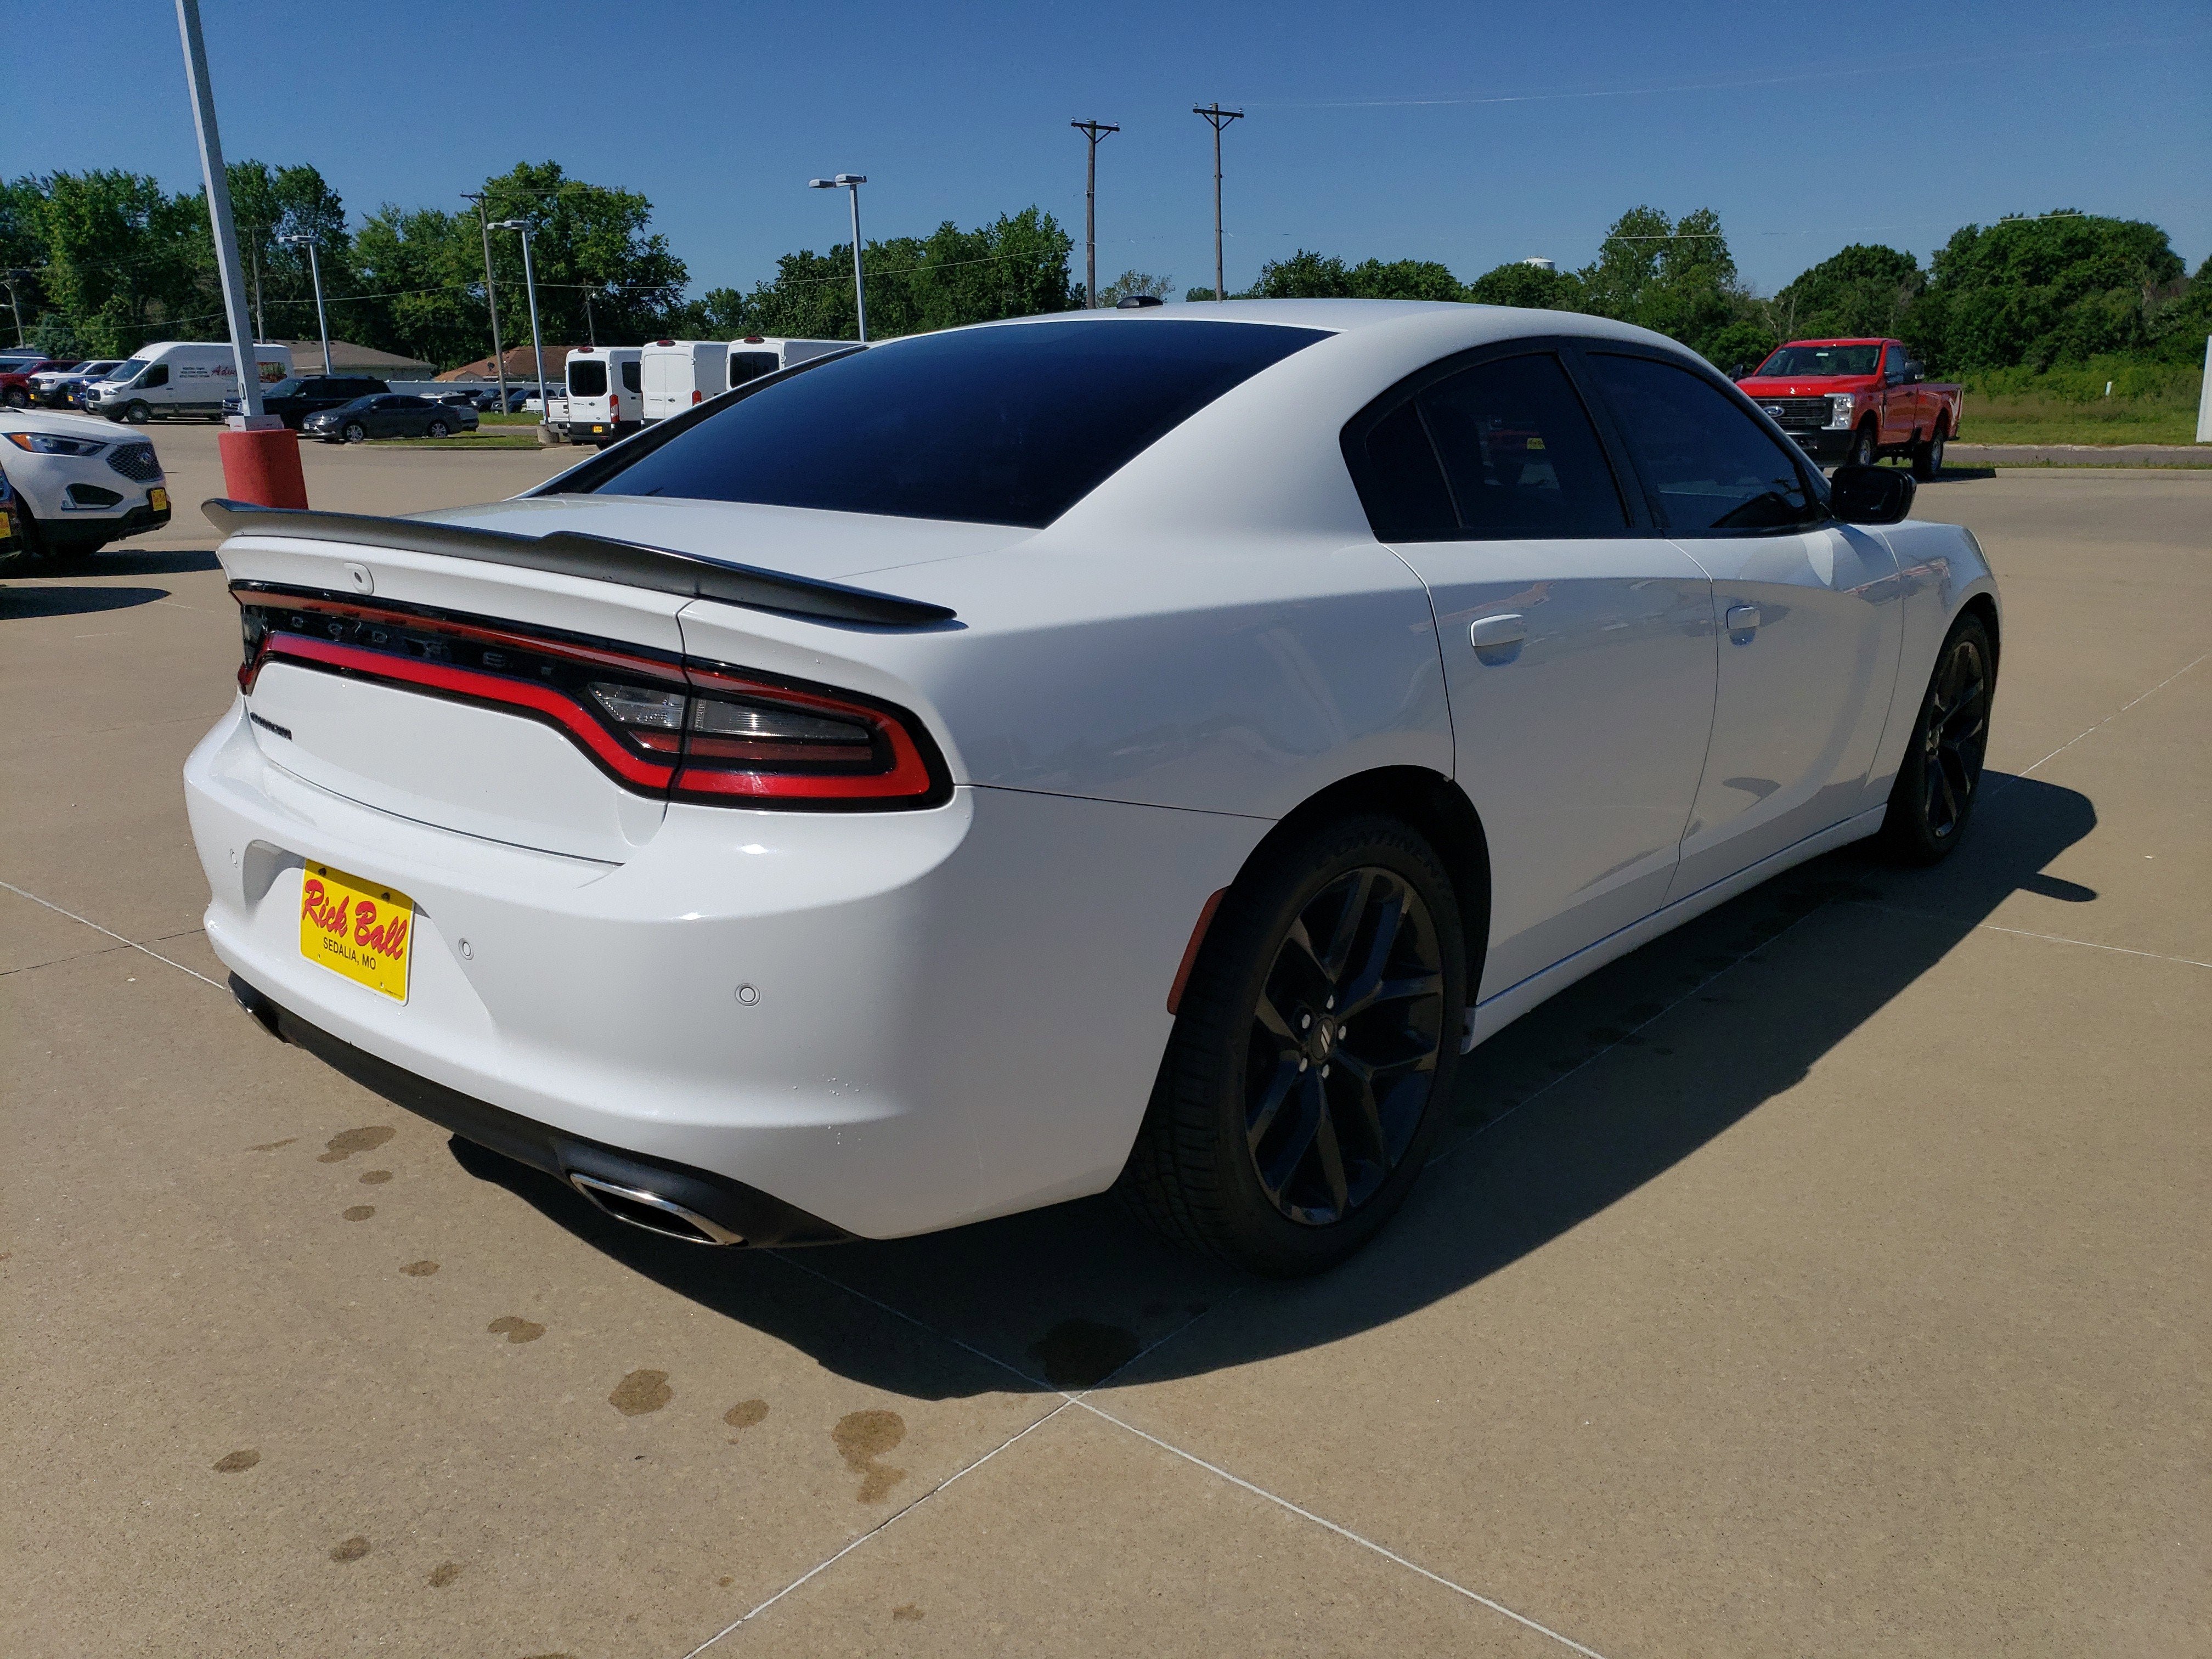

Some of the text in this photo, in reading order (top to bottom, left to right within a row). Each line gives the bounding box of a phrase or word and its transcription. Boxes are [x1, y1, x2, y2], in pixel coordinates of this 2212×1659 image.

[302, 879, 407, 960] Rick Ball
[323, 936, 376, 970] SEDALIA, MO
